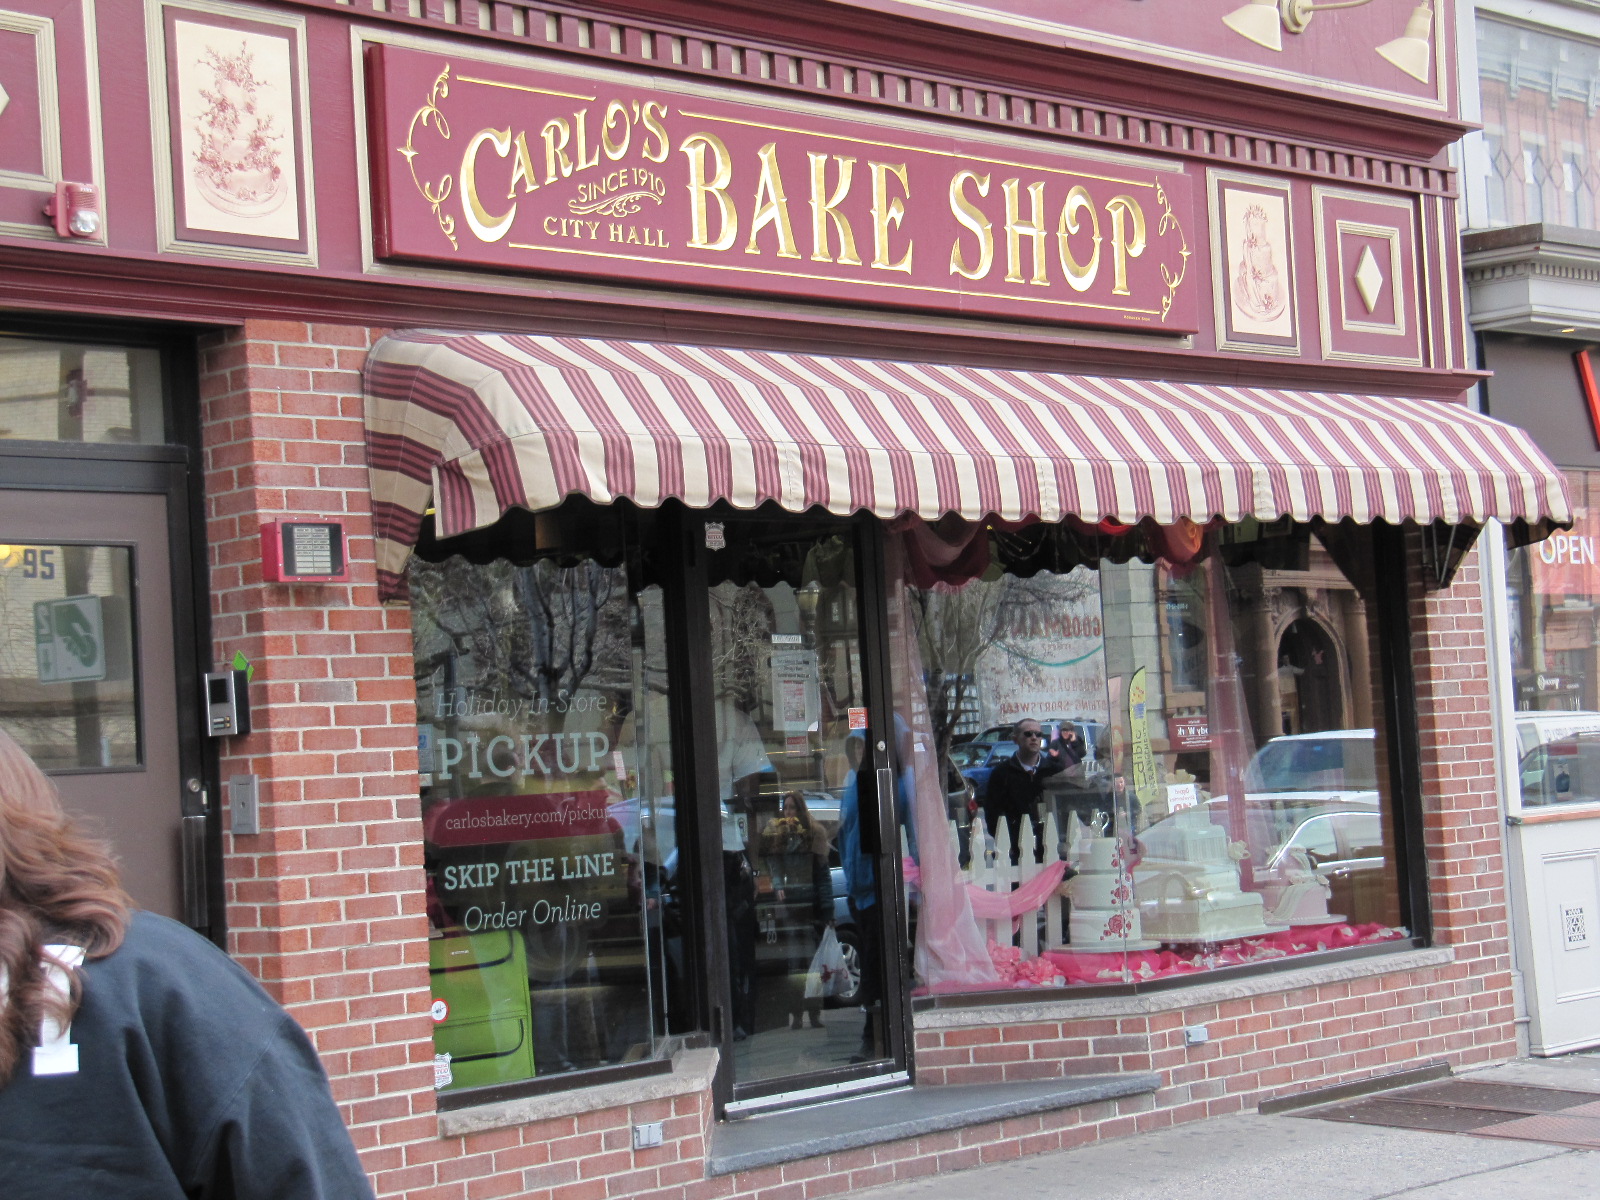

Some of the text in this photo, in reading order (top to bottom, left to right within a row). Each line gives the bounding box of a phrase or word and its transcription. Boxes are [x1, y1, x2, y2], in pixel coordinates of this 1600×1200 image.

[459, 99, 1147, 296] CARLO'S BAKE SHOP
[577, 167, 667, 203] SINCE 1910
[543, 217, 670, 248] CITY HALL
[23, 548, 55, 580] 95
[1539, 535, 1595, 565] OPEN
[434, 687, 607, 721] Holiday In-Store
[437, 731, 610, 781] PICKUP
[444, 853, 615, 890] SKIP THE LINE
[464, 895, 602, 932] Order Online
